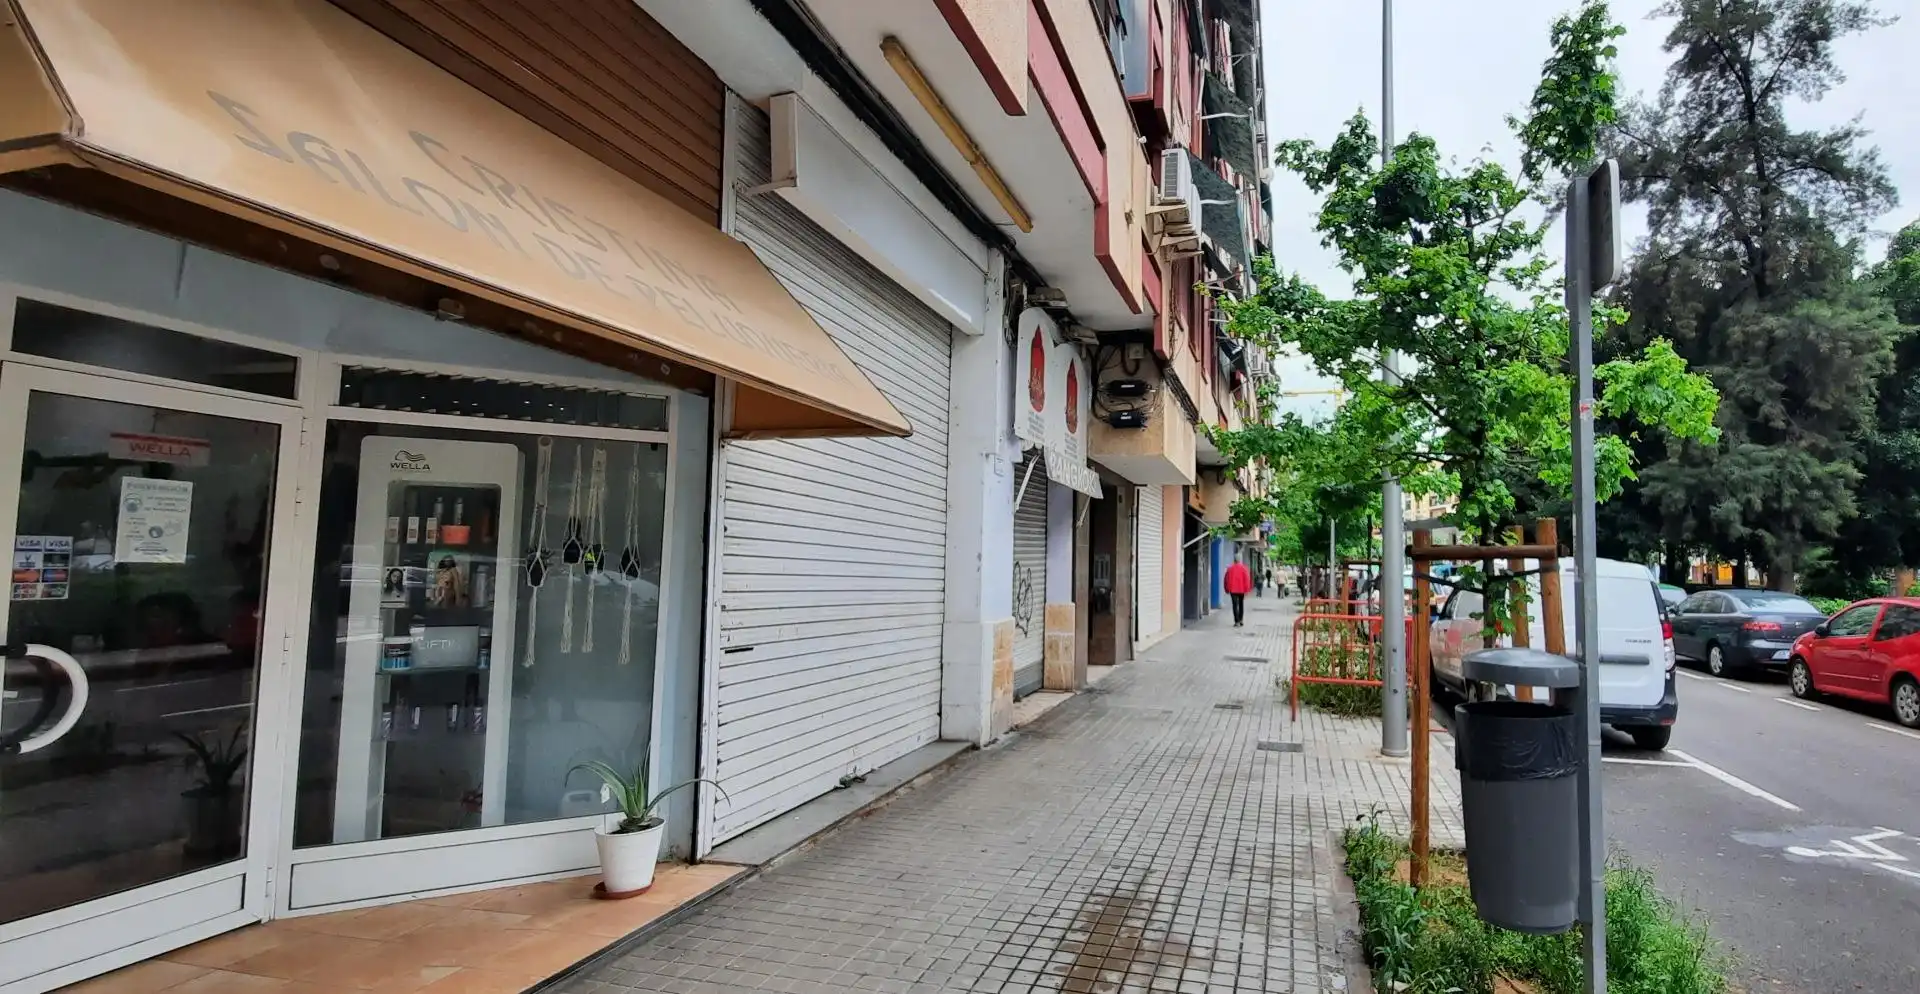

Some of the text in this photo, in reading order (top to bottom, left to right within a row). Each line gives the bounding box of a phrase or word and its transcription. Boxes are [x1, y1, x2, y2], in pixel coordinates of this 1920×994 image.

[206, 89, 534, 261] SALON
[532, 231, 633, 300] DE
[408, 130, 746, 316] CRISTINA
[129, 442, 191, 457] WELLA
[390, 462, 430, 470] WELLA
